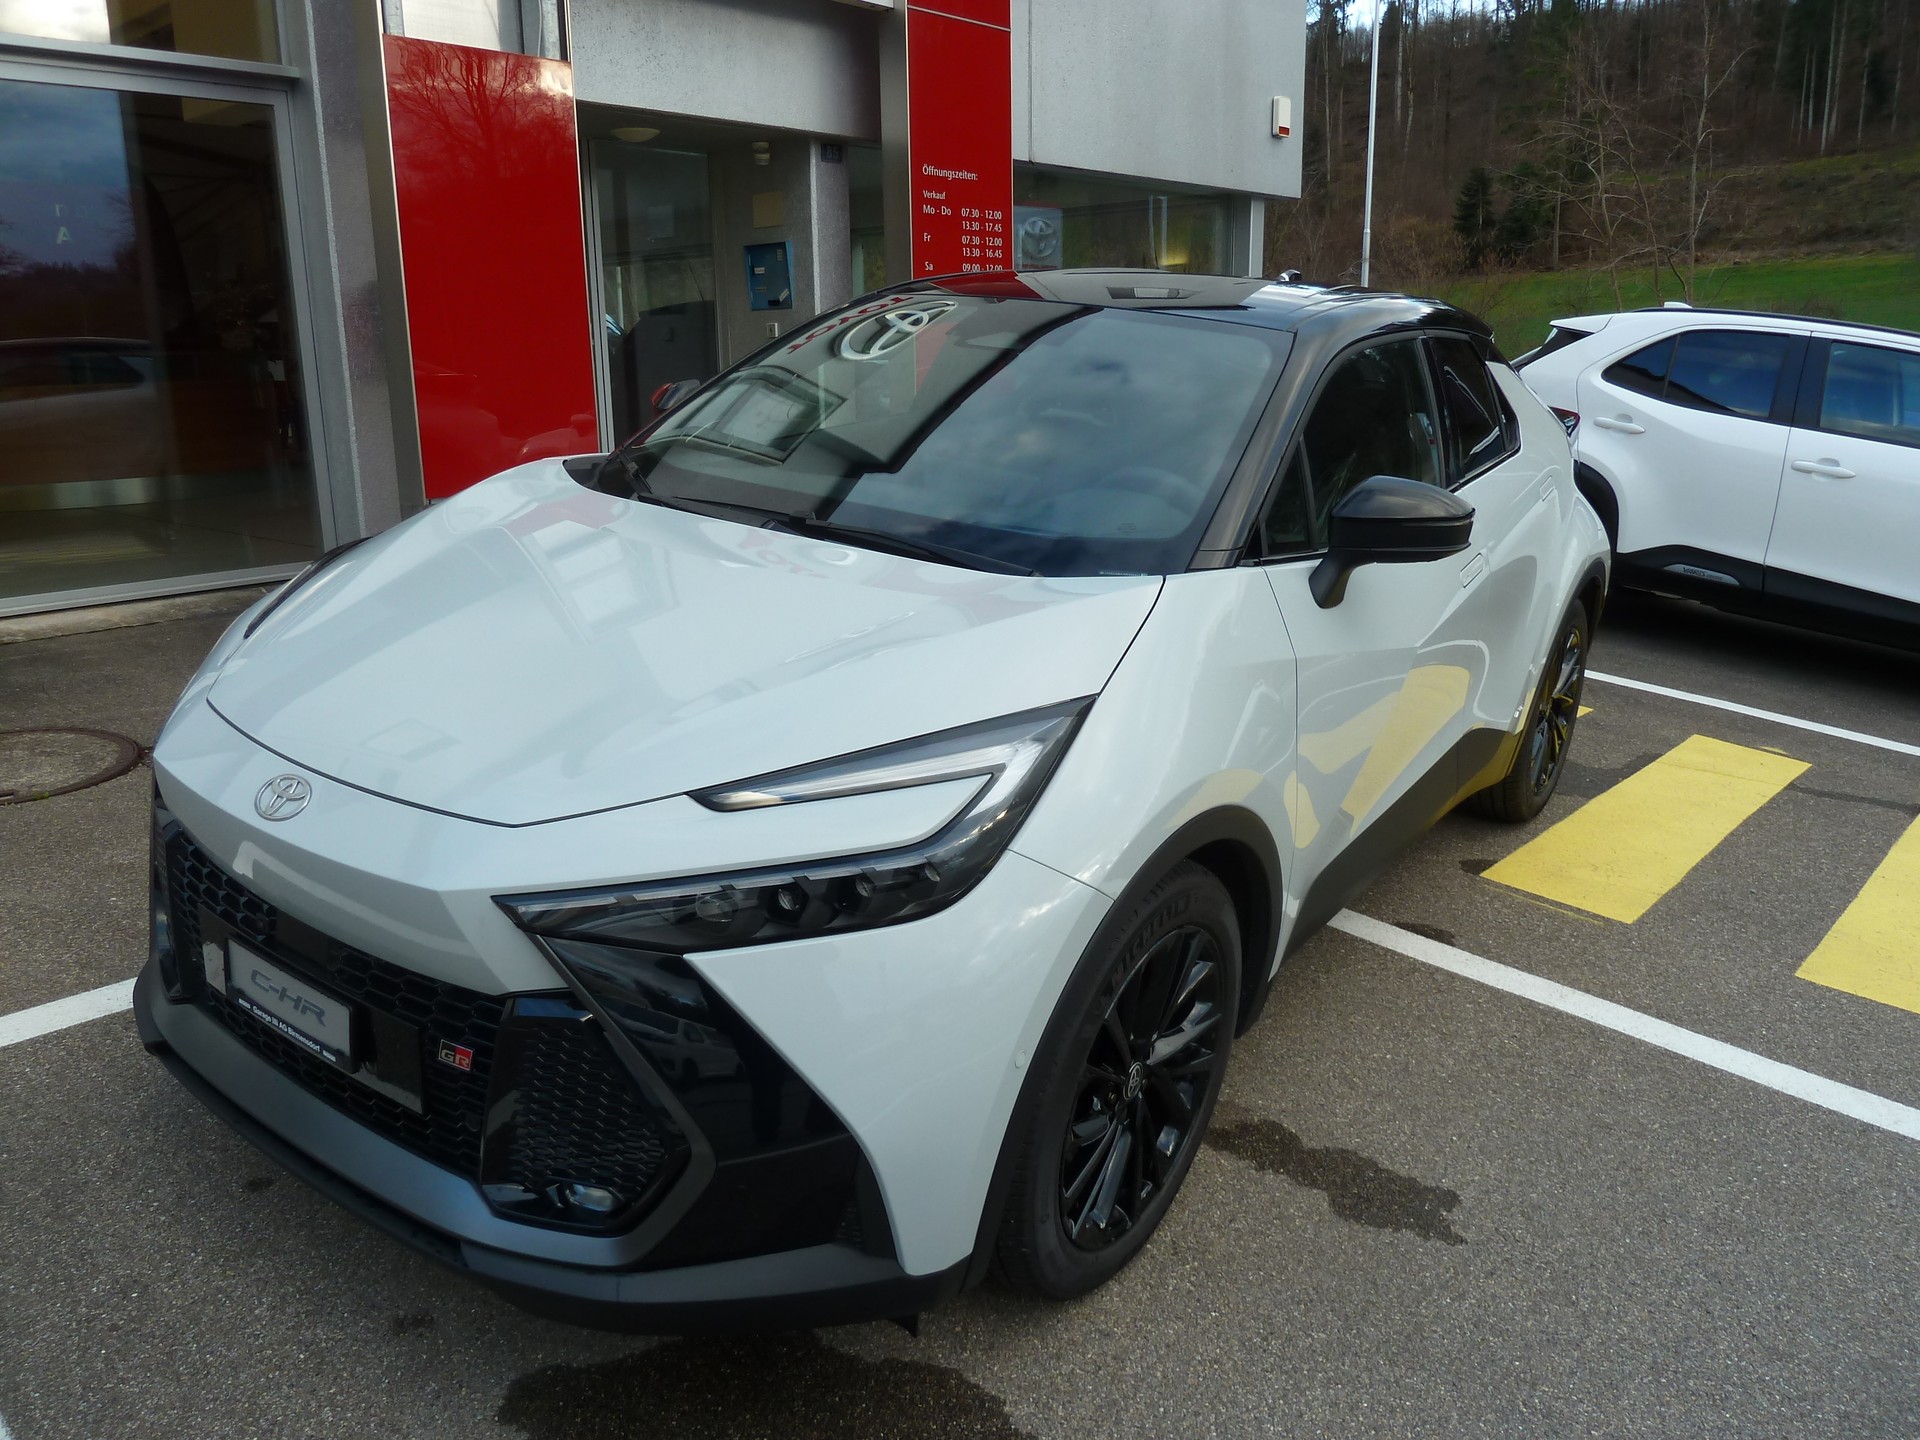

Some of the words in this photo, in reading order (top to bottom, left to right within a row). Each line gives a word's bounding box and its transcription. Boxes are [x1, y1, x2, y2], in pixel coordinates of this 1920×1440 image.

[922, 163, 978, 181] Öffnungszeiten:
[922, 190, 946, 200] Verkauf
[923, 204, 935, 215] Mo
[941, 205, 952, 216] Do
[961, 208, 980, 218] 07.30
[985, 210, 1002, 220] 12.00
[962, 221, 980, 231] 13.30
[985, 222, 1002, 233] 17.45
[923, 233, 931, 242] Fr
[961, 235, 980, 245] 07.30
[985, 237, 1003, 247] 12.00
[962, 247, 980, 257] 13.30
[985, 249, 1003, 259] 16.45
[924, 261, 934, 271] Sa
[962, 263, 980, 272] 09.00
[250, 969, 326, 1027] C-HR
[441, 1048, 470, 1068] GR
